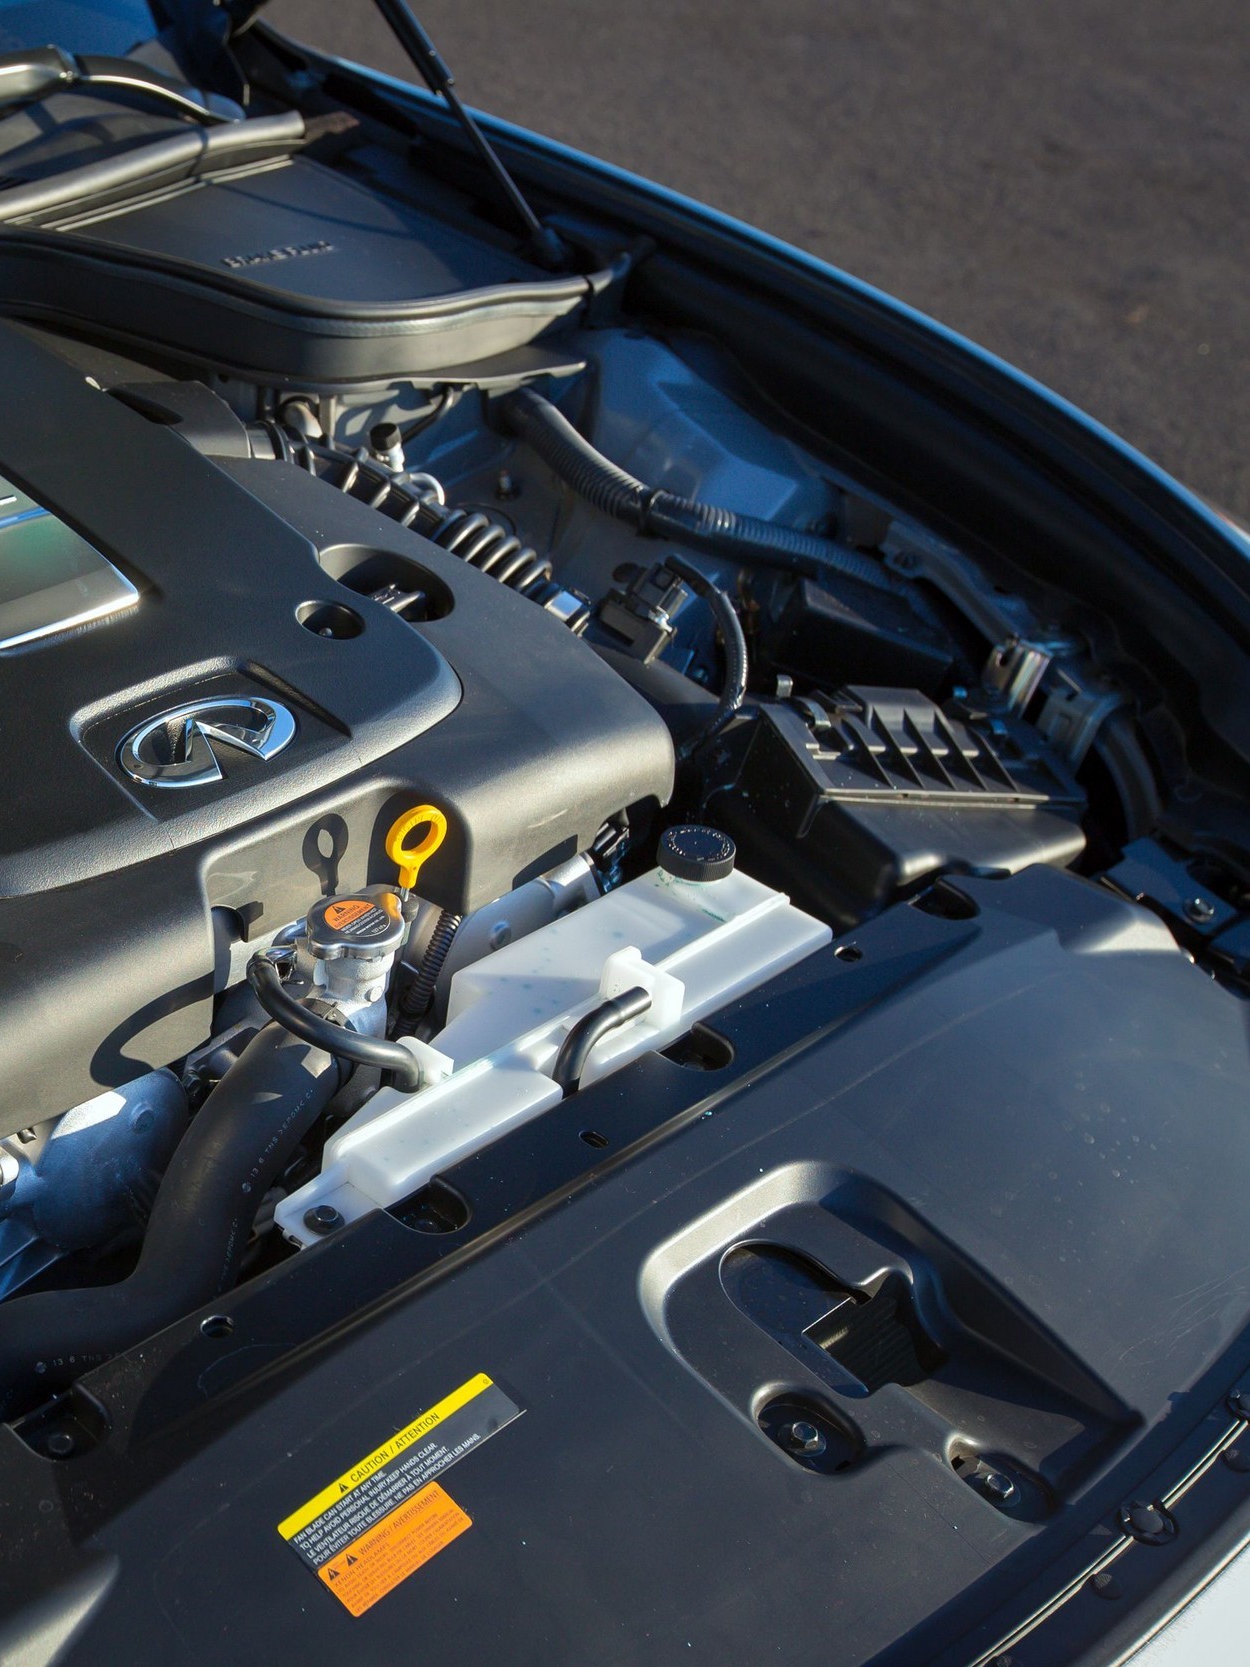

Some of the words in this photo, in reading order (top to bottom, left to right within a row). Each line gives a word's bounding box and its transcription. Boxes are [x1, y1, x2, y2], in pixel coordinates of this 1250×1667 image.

[334, 905, 360, 922] WARNING
[350, 1450, 390, 1483] CAUTION
[394, 1412, 441, 1449] ATTENTION
[293, 1531, 308, 1544] FAN
[305, 1517, 326, 1535] BLADE
[323, 1508, 338, 1521] CAN
[335, 1495, 355, 1511] START
[352, 1489, 362, 1498] AT
[359, 1480, 374, 1492] ANY
[300, 1541, 311, 1551] TO
[308, 1529, 326, 1544] HELP
[323, 1516, 342, 1533] AVOID
[339, 1494, 371, 1519] PERSONAL
[399, 1456, 420, 1473] HANDS
[307, 1549, 317, 1559] LE
[314, 1522, 352, 1552] VENTILATEUR
[348, 1506, 372, 1526] RISQUE
[369, 1499, 380, 1510] DE
[376, 1476, 409, 1503] DÉMARRER
[410, 1463, 427, 1477] TOUT
[313, 1549, 332, 1565] POUR
[328, 1533, 351, 1552] ÉVITER
[348, 1520, 368, 1537] TOUTE
[394, 1491, 405, 1501] NE
[402, 1483, 416, 1495] PAS
[413, 1477, 423, 1487] EN
[420, 1453, 455, 1481] APPROCHER
[452, 1445, 465, 1457] LES
[358, 1528, 391, 1555] WARNING
[392, 1491, 440, 1529] AVERTISSEMENT
